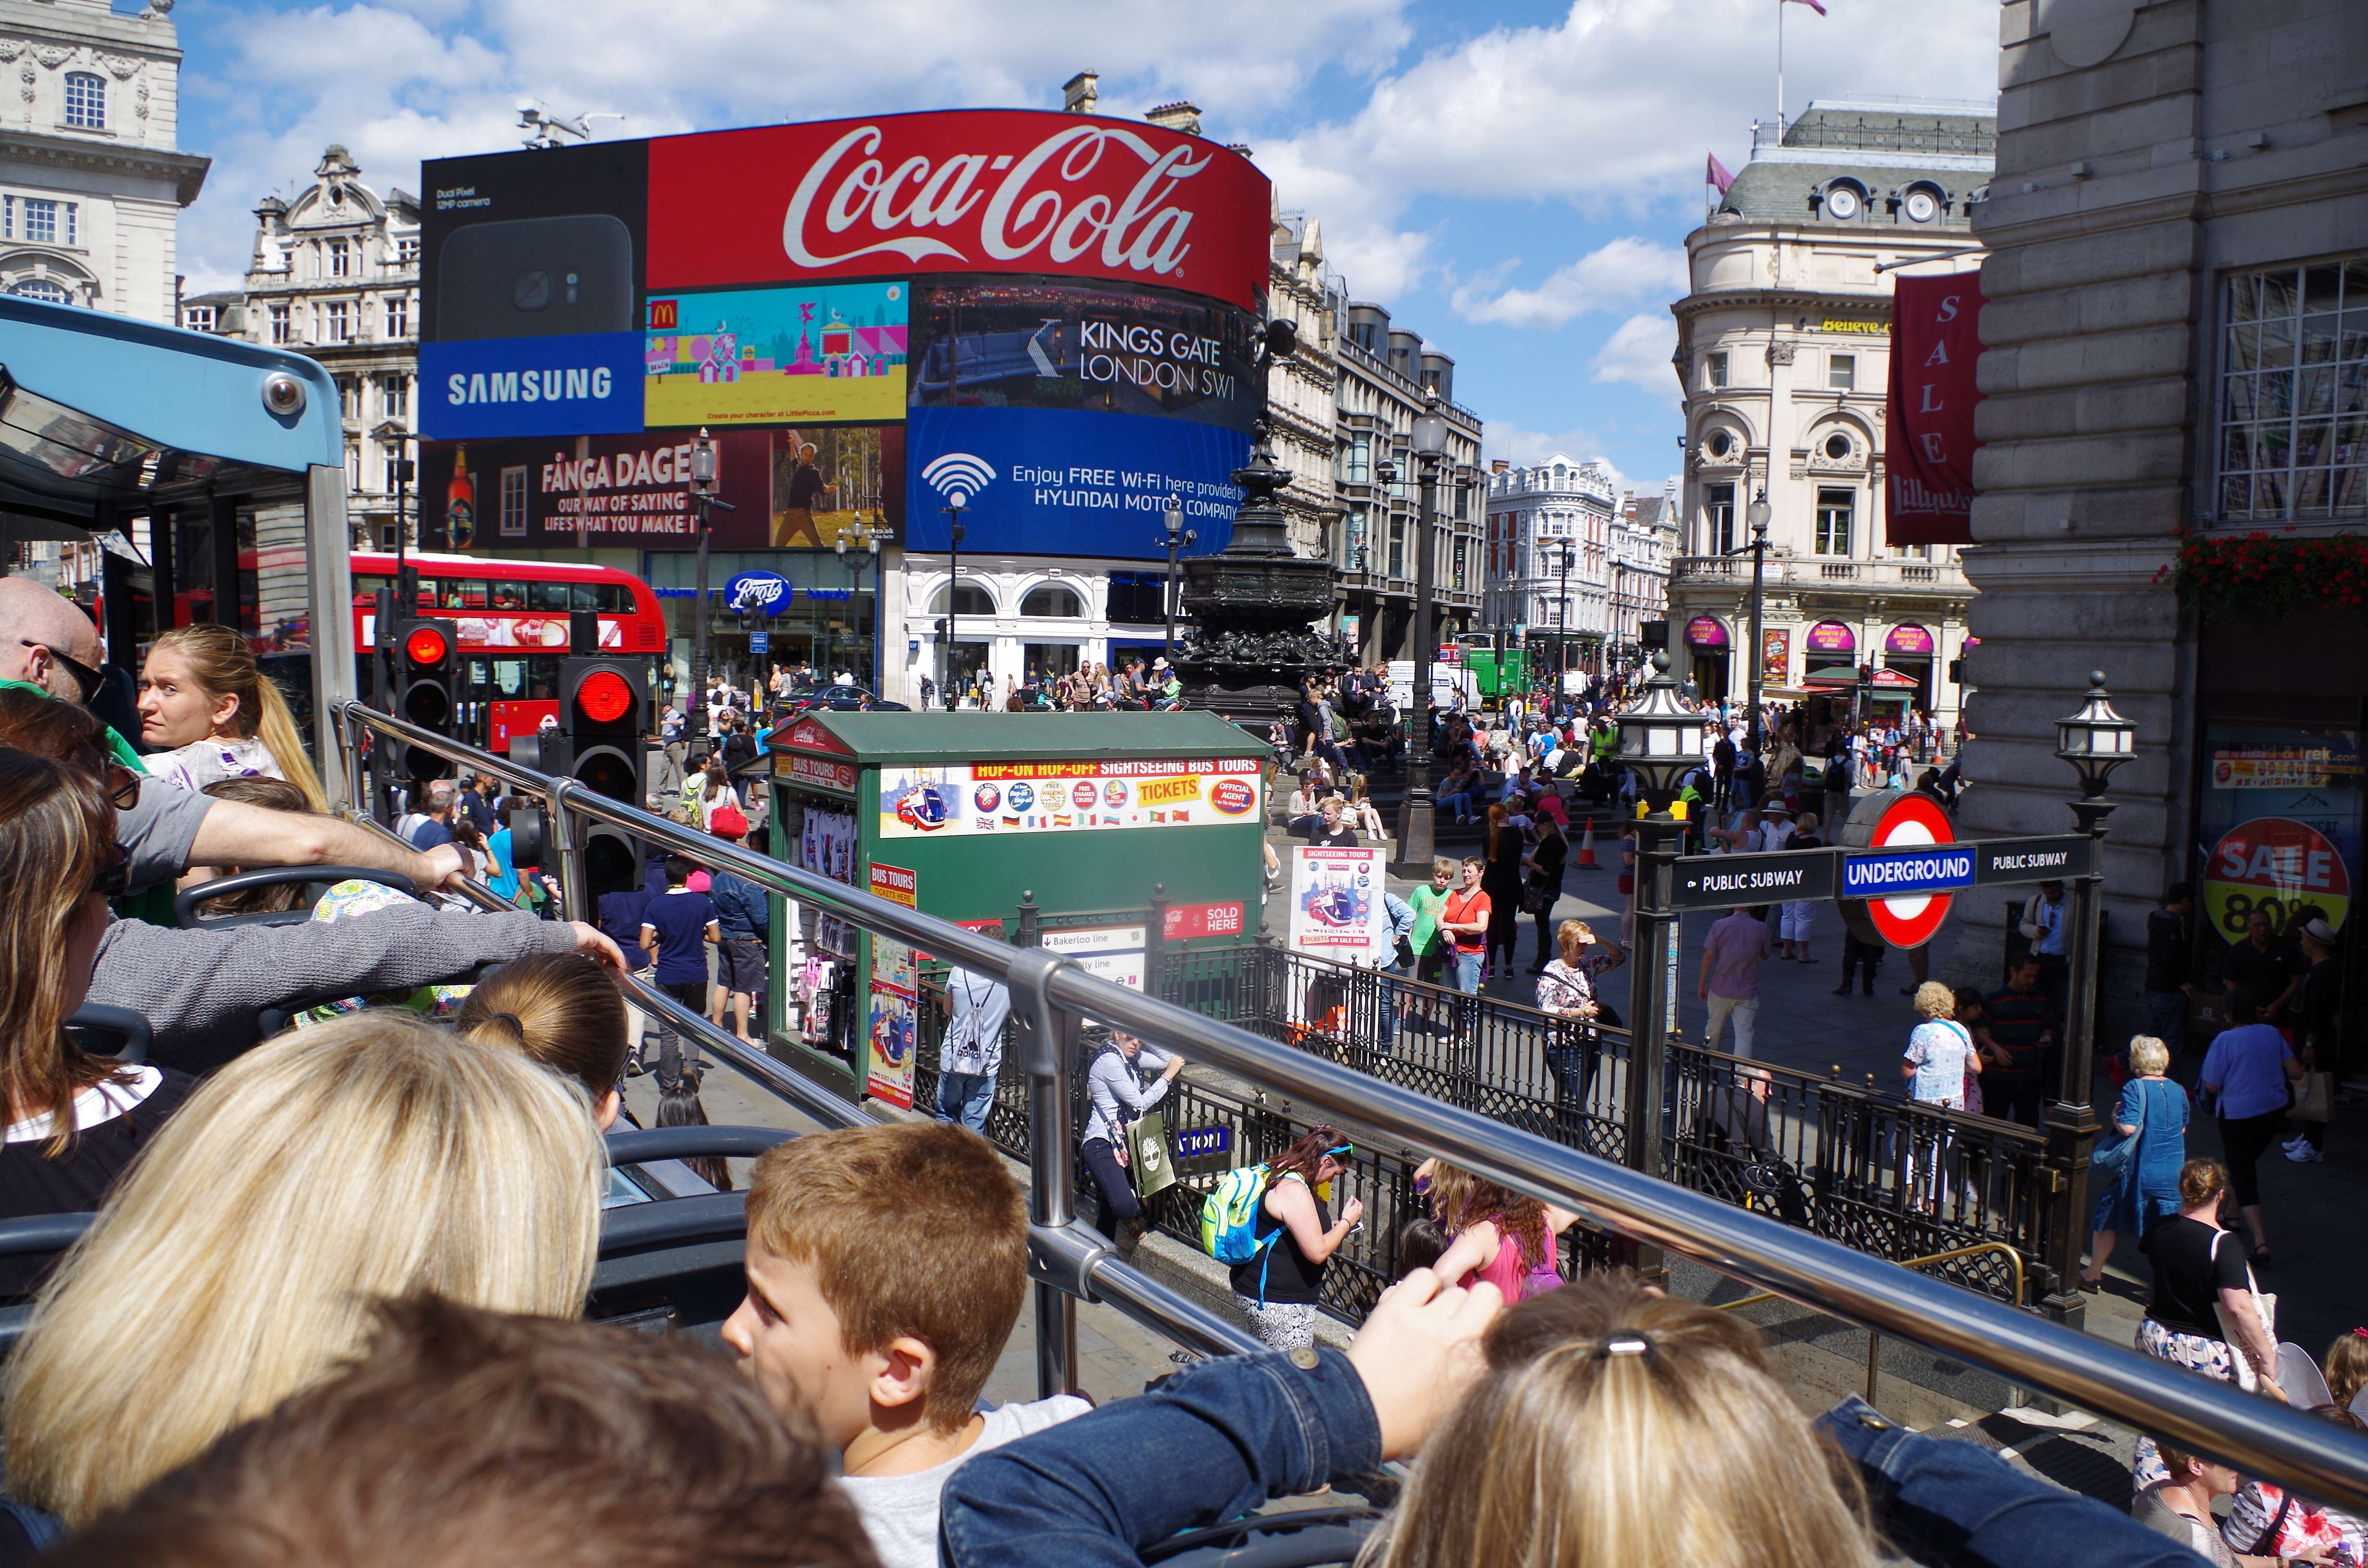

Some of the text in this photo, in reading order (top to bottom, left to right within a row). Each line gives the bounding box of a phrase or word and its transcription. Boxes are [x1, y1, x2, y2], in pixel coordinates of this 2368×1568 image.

[436, 189, 455, 198] Dual
[457, 198, 491, 208] camera
[783, 124, 1213, 274] Coca-Cola
[1081, 320, 1221, 367] KINGS GATE
[650, 363, 669, 371] BEACH
[1080, 353, 1234, 401] LONDON SW1
[448, 366, 611, 405] SAMSUNG
[1919, 295, 1961, 464] SALE
[542, 441, 718, 493] FÅNGA DAGE
[1012, 466, 1062, 486] Enjoy
[1069, 467, 1115, 486] FREE
[1121, 471, 1160, 490] Wi-Fi
[1165, 475, 1194, 493] here
[1198, 483, 1236, 500] provided
[558, 492, 688, 513] OUR WAY OF SAYING
[1035, 488, 1119, 508] HYUNDAI
[1186, 499, 1237, 521] COMPANY
[544, 516, 576, 531] LIFE'S
[576, 515, 611, 531] WHAT
[611, 515, 641, 532] YOU
[641, 515, 689, 533] MAKE
[793, 758, 835, 778] BUS TOURS
[978, 758, 1257, 777] HOP-ON HOP-OFF SIGHTSEEING BUS TOURS
[976, 785, 985, 794] LIVE
[1140, 779, 1197, 800] TICKETS
[1219, 783, 1250, 793] OFFICIAL
[1221, 792, 1246, 801] AGENT
[1848, 857, 1970, 885] UNDERGROUND
[1993, 852, 2067, 870] PUBLIC SUBWAY
[2220, 840, 2332, 887] SALE
[872, 867, 913, 890] BUS TOURS
[1703, 870, 1803, 892] PUBLIC SUBWAY
[874, 887, 911, 903] TICKETS HERE
[1207, 907, 1238, 920] SOLD
[1207, 918, 1238, 931] HERE
[1053, 934, 1108, 945] Bakerloo line
[1095, 960, 1110, 968] line
